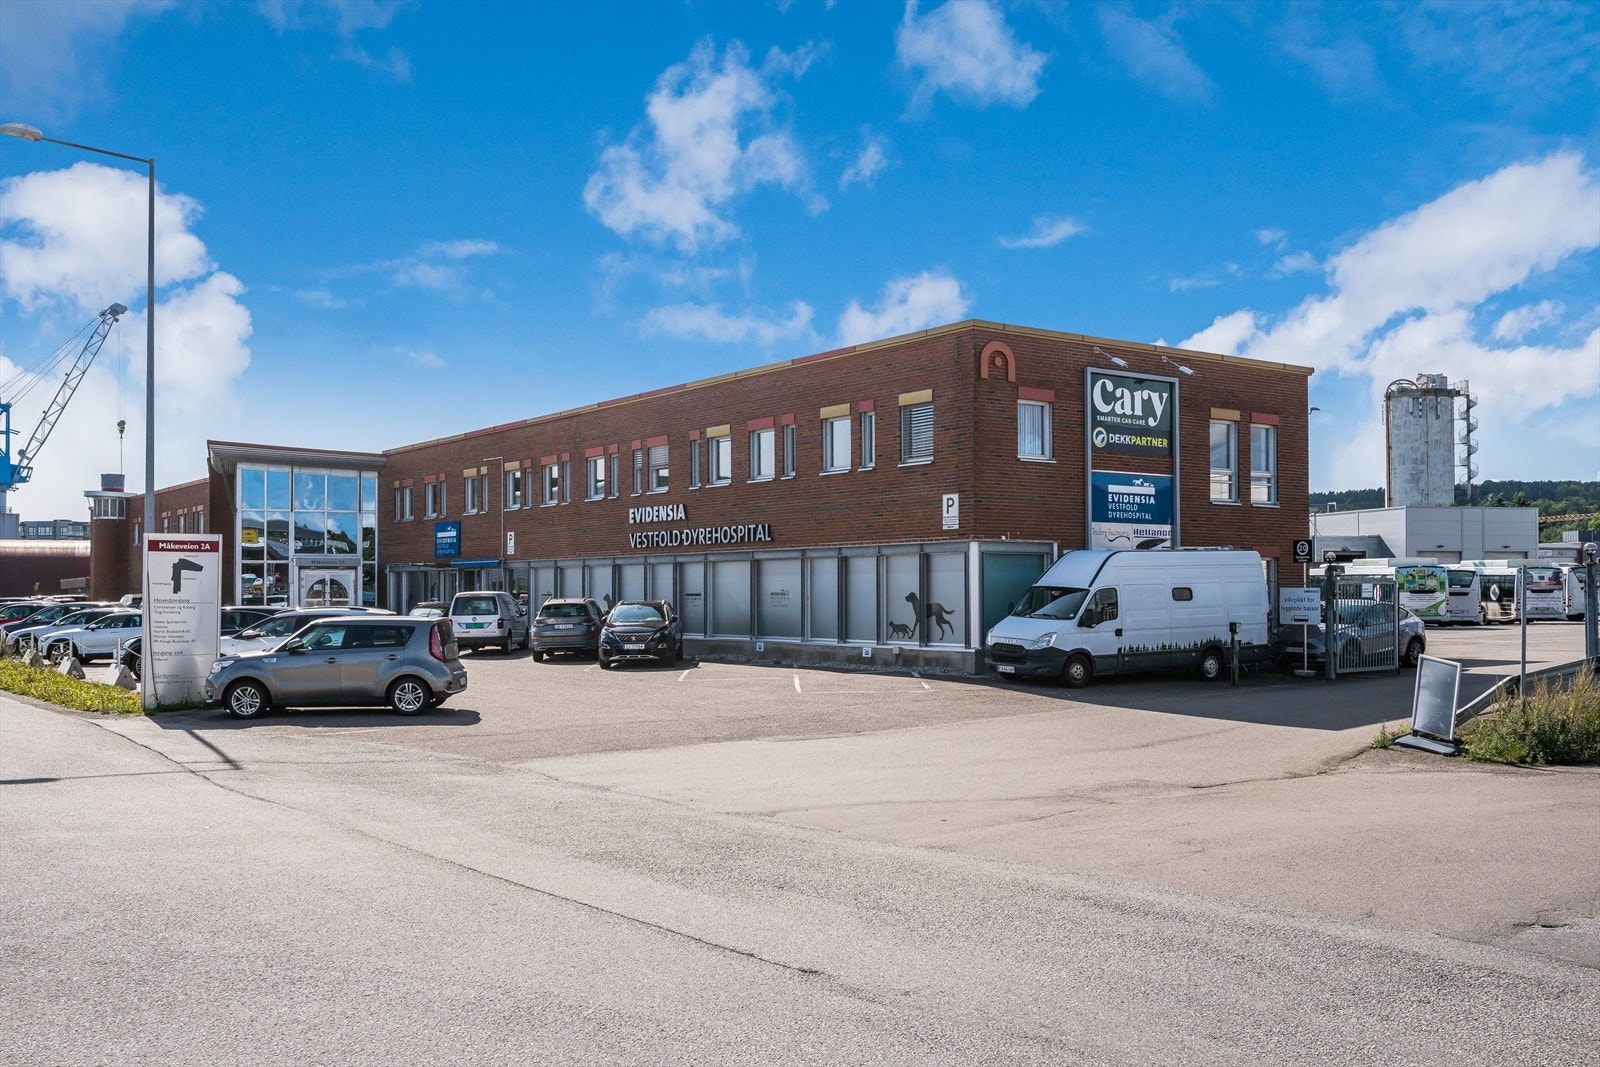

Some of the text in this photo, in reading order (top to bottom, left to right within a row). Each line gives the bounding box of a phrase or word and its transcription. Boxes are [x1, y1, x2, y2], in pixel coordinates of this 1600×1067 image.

[1093, 379, 1169, 427] Cary
[1097, 415, 1120, 423] SMARTER
[1108, 433, 1168, 448] DEKKPARTNER
[1108, 493, 1156, 504] EVIDENSIA
[946, 497, 955, 514] P
[1108, 503, 1138, 511] VESTFOLD
[629, 504, 686, 524] EVIDENSIA
[1108, 511, 1152, 520] DYREHOSPITAL
[508, 533, 513, 545] P
[629, 523, 772, 549] VESTFOLD DYREHOSPITAL
[159, 542, 199, 550] Måkeveien
